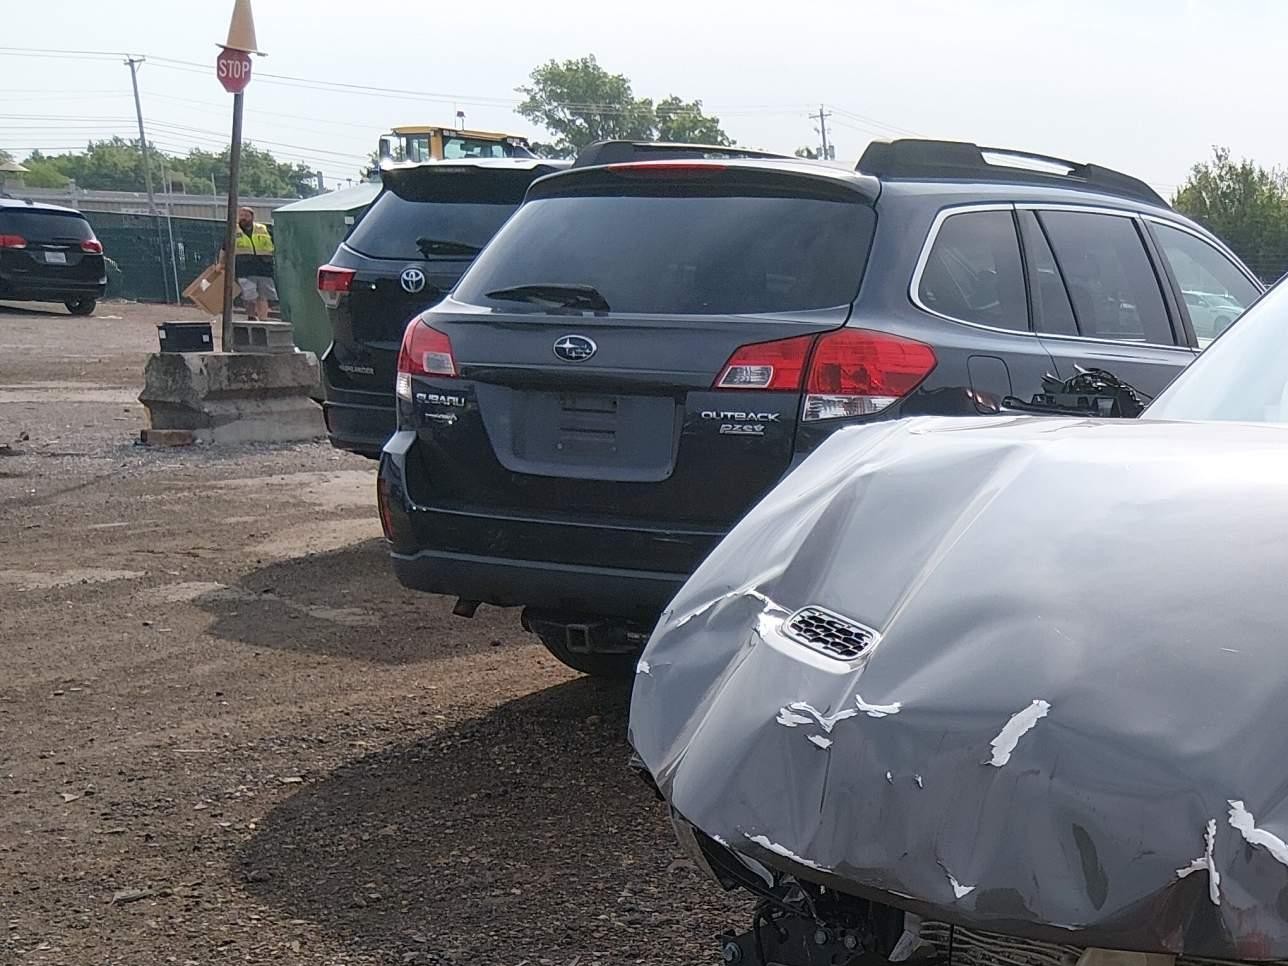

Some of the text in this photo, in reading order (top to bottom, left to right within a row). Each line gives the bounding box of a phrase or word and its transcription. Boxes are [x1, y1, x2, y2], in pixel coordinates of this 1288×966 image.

[219, 59, 250, 79] STOP
[416, 393, 465, 407] SUBARU
[701, 411, 780, 422] OUTBACK
